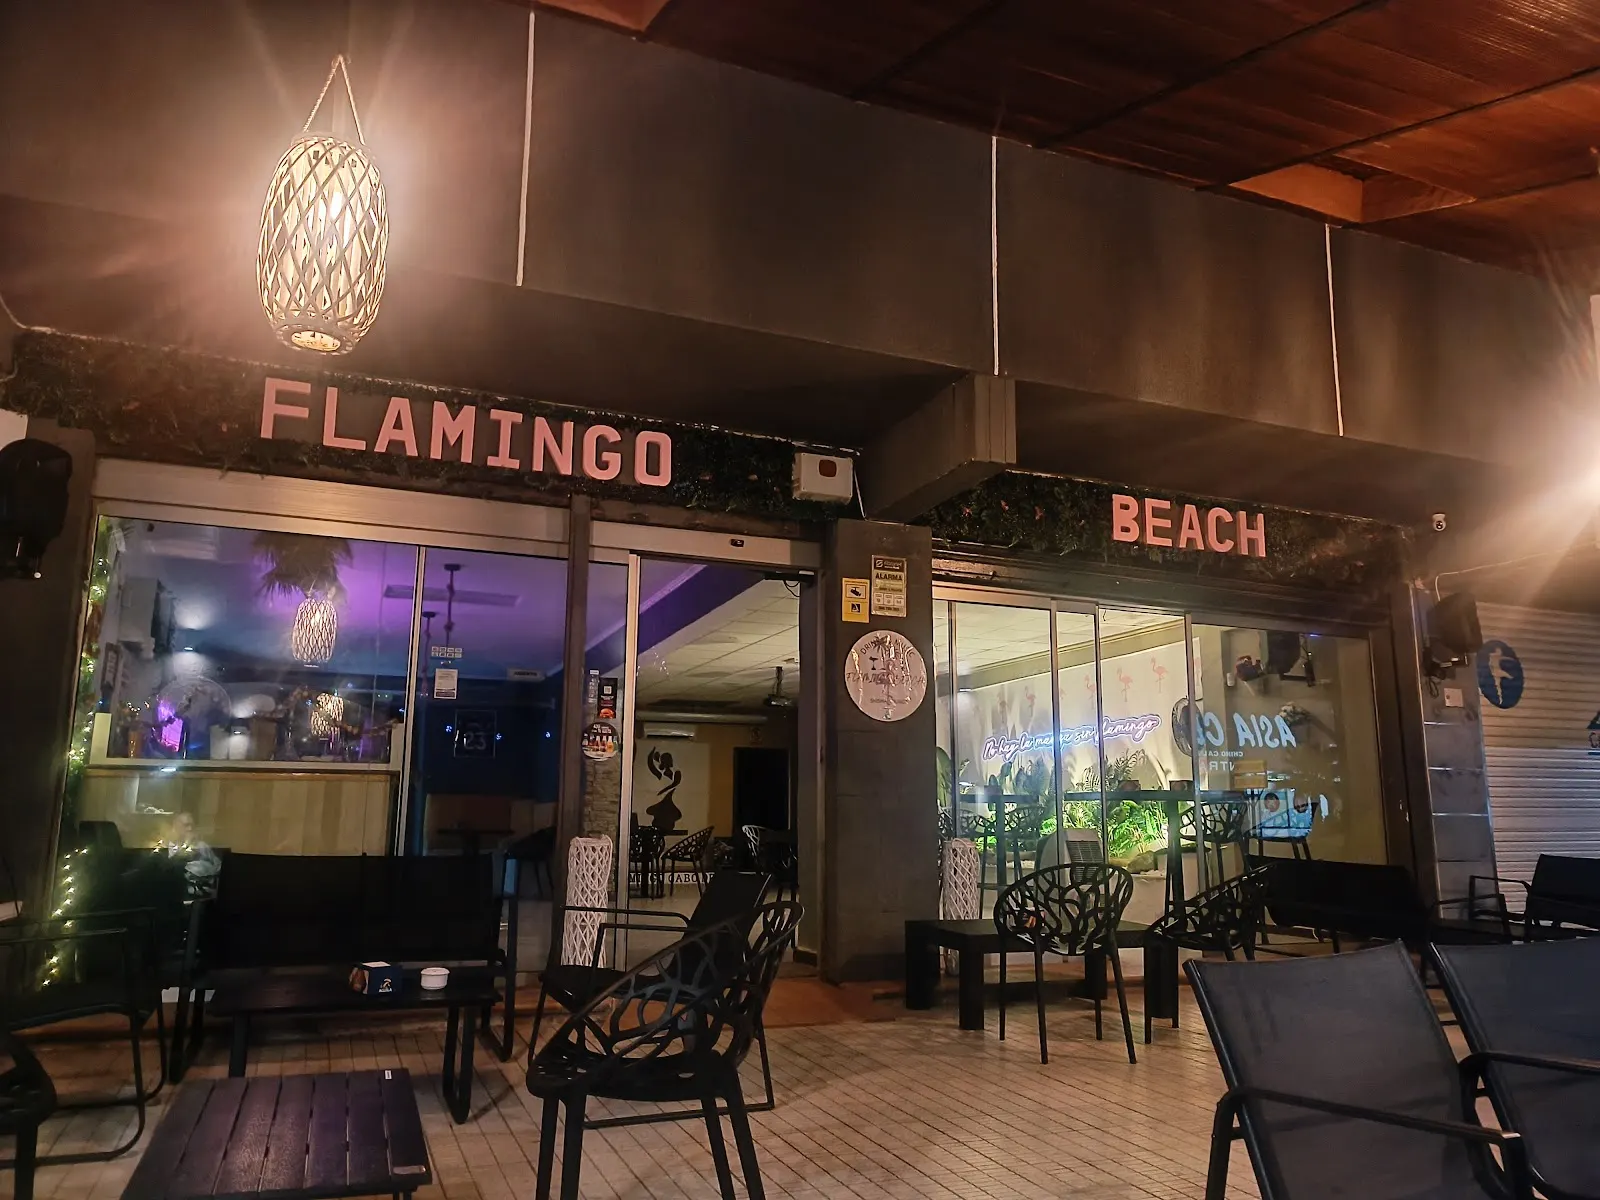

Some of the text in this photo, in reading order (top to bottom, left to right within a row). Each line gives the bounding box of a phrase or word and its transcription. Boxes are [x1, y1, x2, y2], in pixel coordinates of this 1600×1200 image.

[260, 377, 672, 487] FLAMINGO
[1112, 494, 1266, 558] BEACH
[875, 572, 903, 581] ALARMA
[998, 739, 1019, 760] hay
[1020, 736, 1033, 750] la
